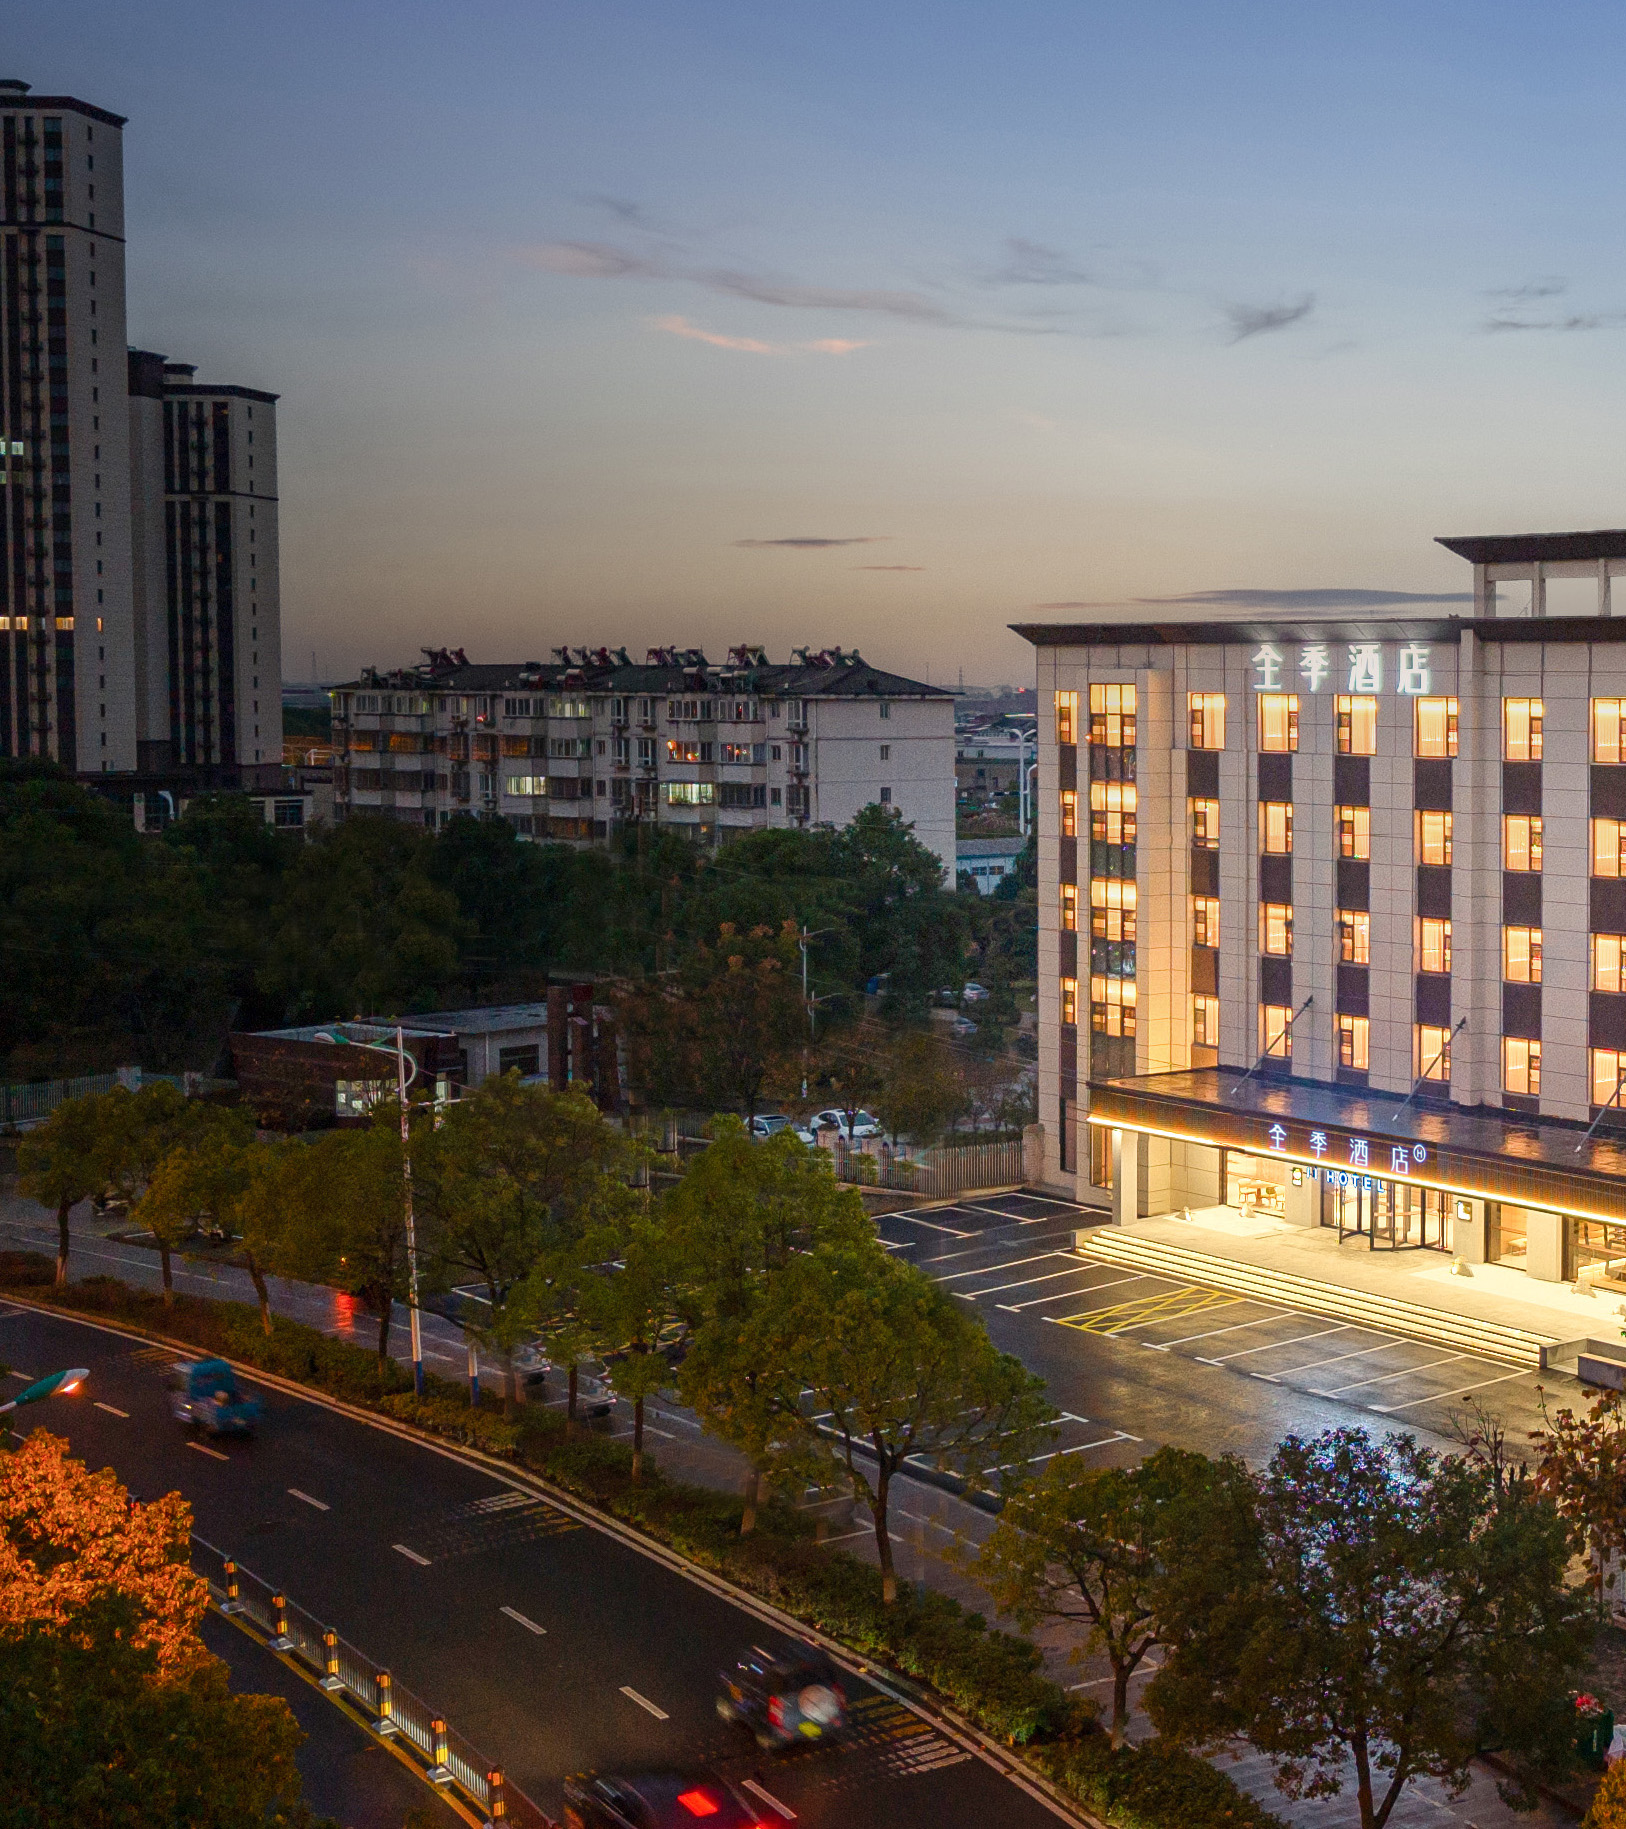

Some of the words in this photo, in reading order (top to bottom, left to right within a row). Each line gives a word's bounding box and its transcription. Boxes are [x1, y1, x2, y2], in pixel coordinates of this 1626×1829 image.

[1252, 645, 1430, 693] 全季酒店
[1269, 1124, 1409, 1174] 全季酒店
[1326, 1170, 1385, 1193] HOTEL
